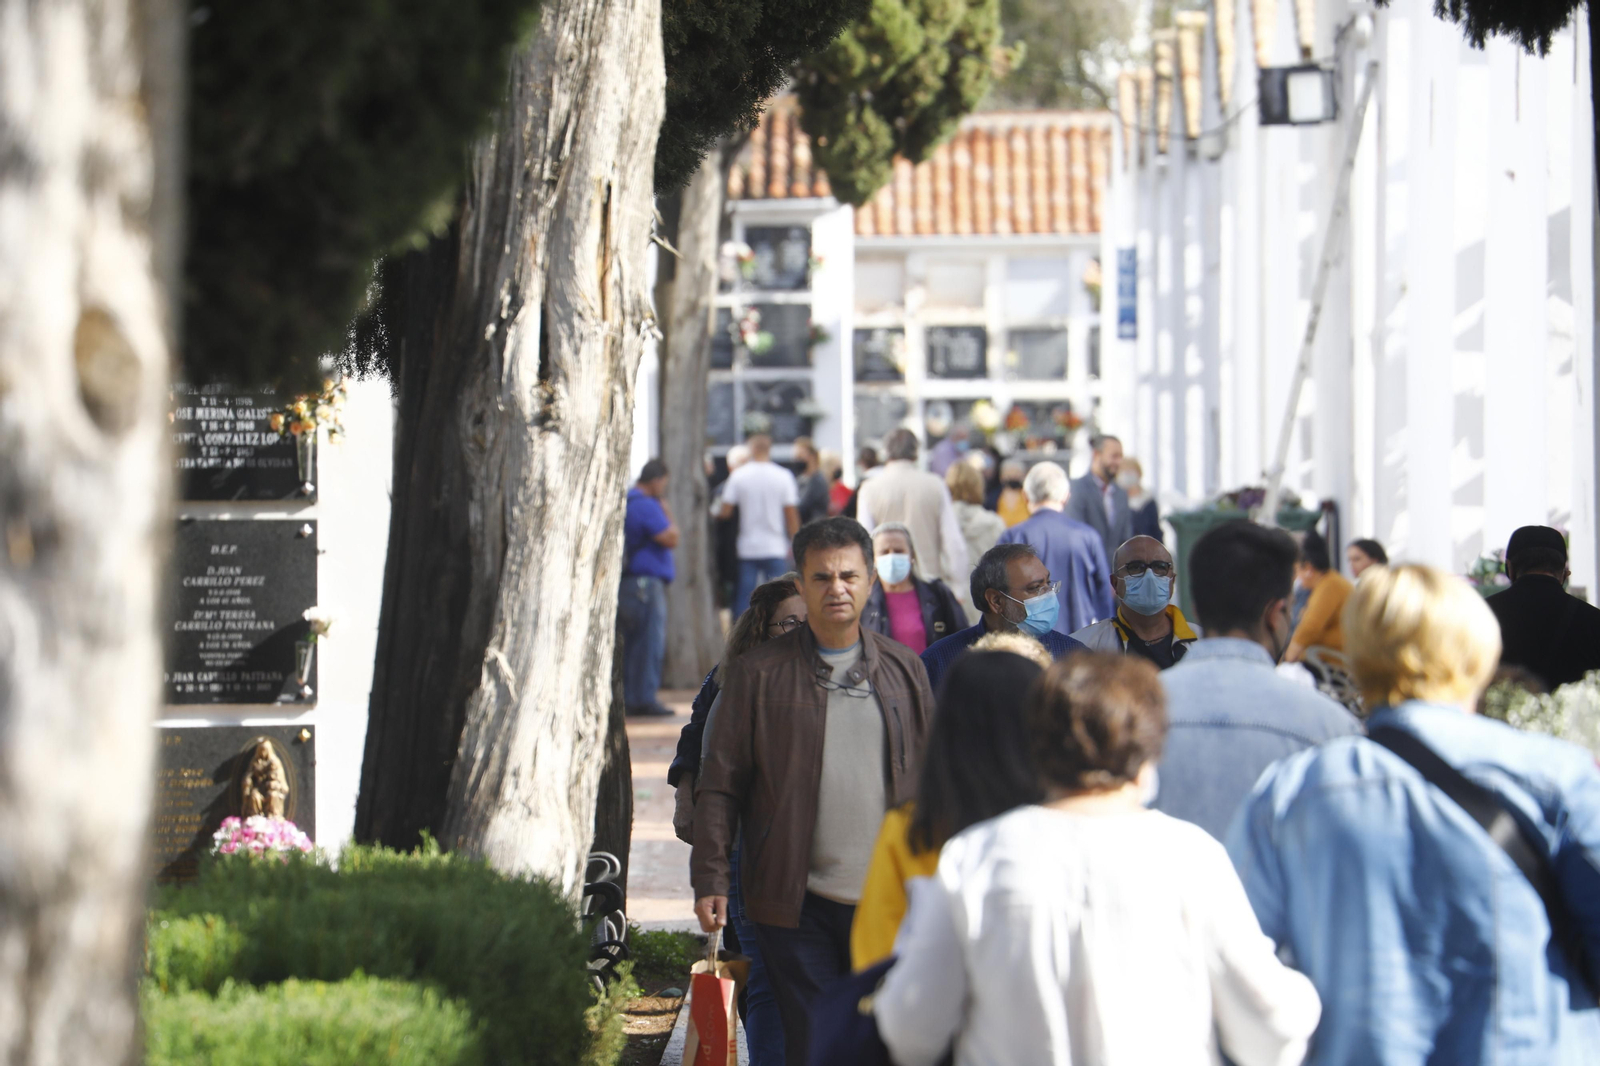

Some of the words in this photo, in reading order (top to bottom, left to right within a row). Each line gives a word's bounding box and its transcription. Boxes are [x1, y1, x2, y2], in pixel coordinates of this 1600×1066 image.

[175, 407, 193, 420] OSE
[204, 432, 260, 446] GONZALEZ
[182, 576, 232, 588] CARRILLO
[233, 576, 266, 587] PEREZ
[174, 620, 223, 632] CARRILLO
[224, 620, 275, 631] PASTRANA
